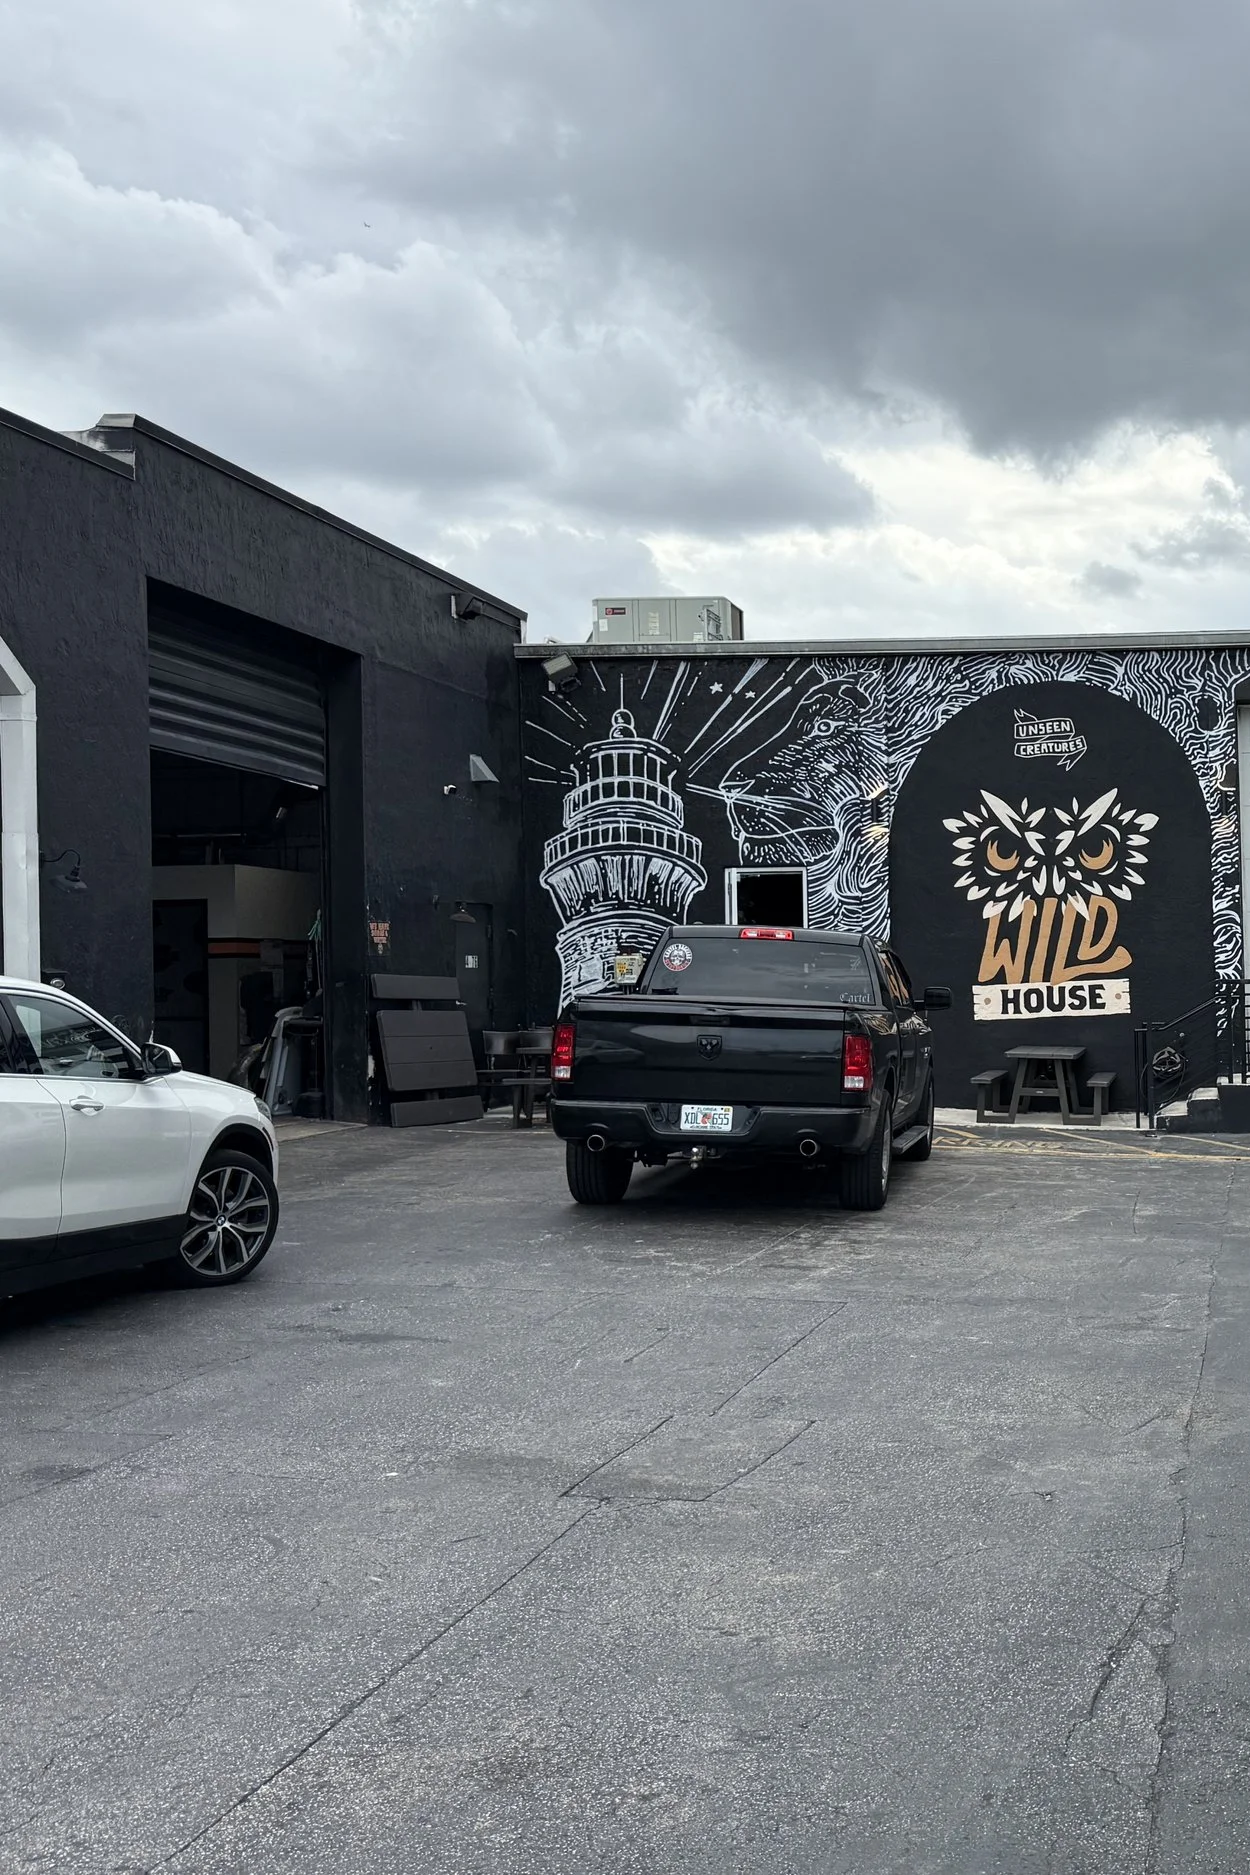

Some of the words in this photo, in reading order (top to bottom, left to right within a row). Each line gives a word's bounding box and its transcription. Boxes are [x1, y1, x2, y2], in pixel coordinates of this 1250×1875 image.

[1019, 721, 1070, 736] UNSEEN
[1020, 739, 1083, 755] CREATURES
[978, 895, 1132, 986] WILD
[840, 992, 870, 1003] Cartel
[1001, 984, 1106, 1015] HOUSE
[932, 1136, 1064, 1150] RKING
